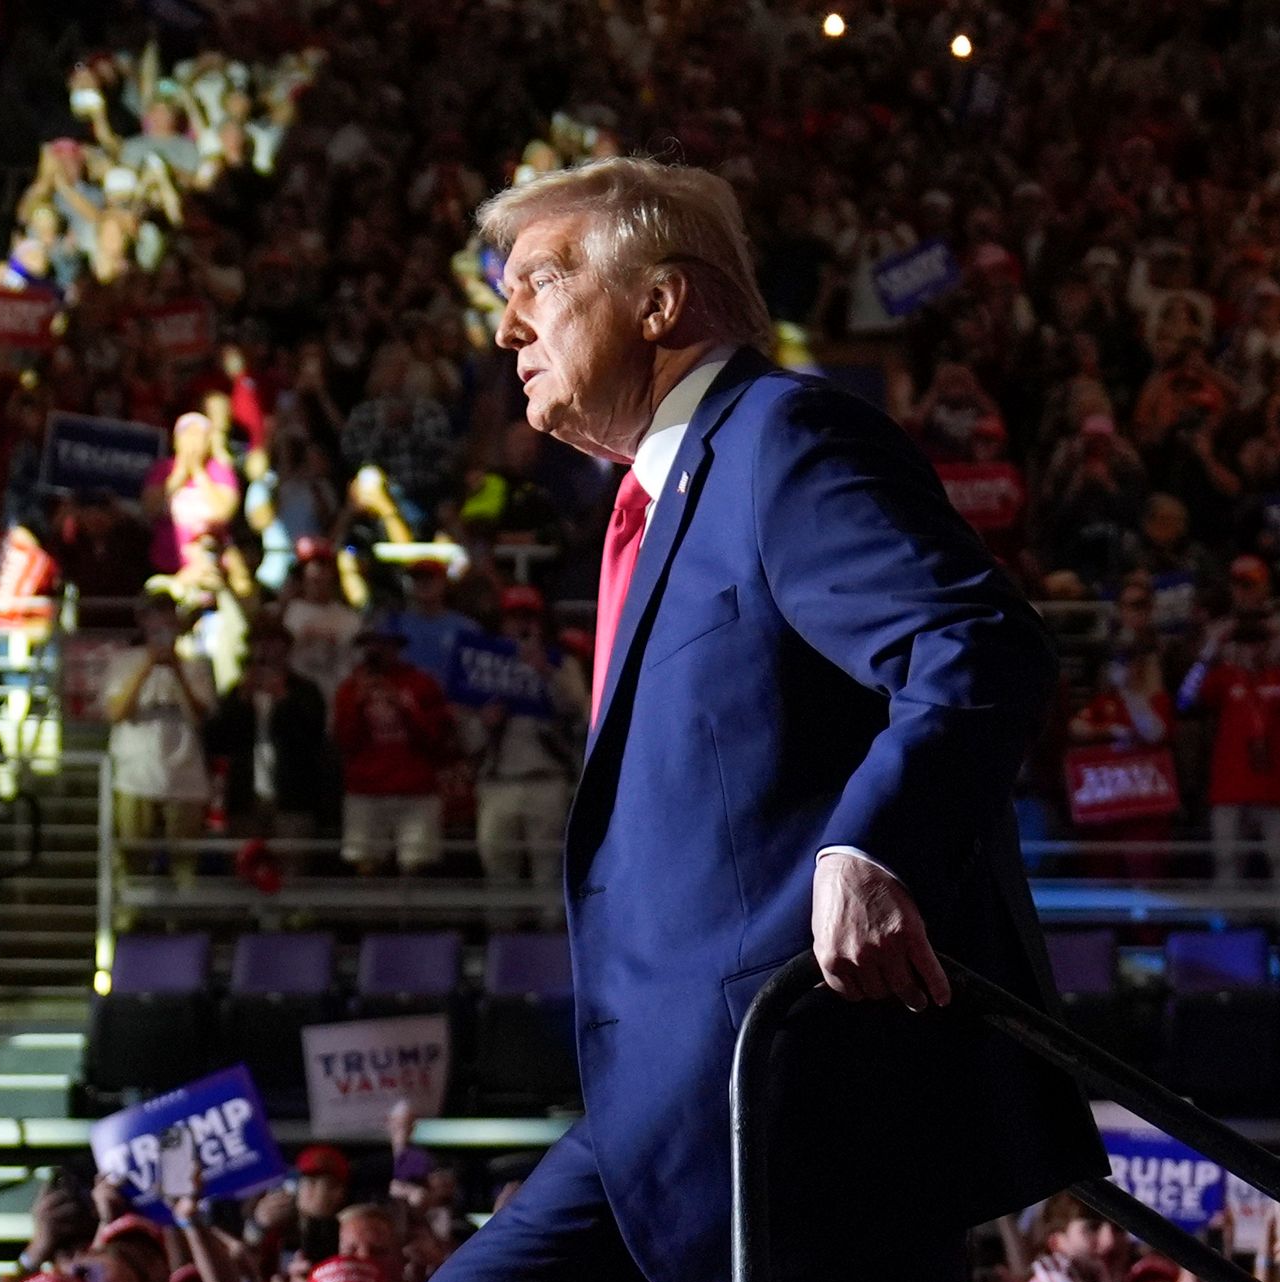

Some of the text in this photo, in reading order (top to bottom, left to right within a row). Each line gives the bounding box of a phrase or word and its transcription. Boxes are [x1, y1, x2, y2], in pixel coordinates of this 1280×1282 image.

[320, 1044, 442, 1075] TRUMP
[105, 1097, 253, 1180] TRMP
[127, 1126, 250, 1192] VCE
[1108, 1154, 1222, 1187] RUMP
